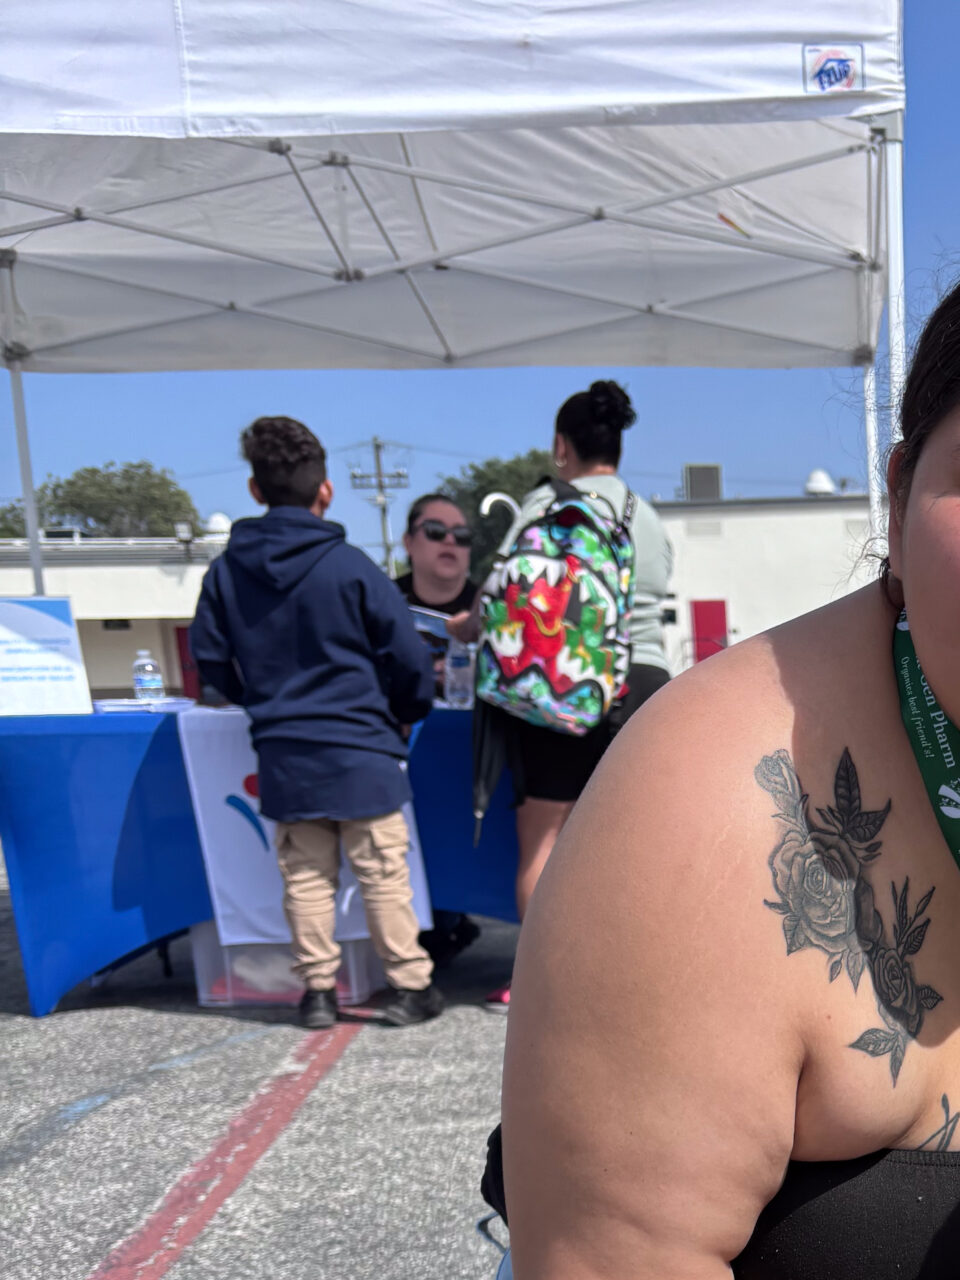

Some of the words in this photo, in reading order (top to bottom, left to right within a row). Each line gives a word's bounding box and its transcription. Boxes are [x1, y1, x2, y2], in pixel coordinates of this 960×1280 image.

[901, 656, 913, 696] Organics
[908, 696, 920, 715] best
[911, 716, 935, 758] friend's!
[930, 710, 956, 769] Pharm
